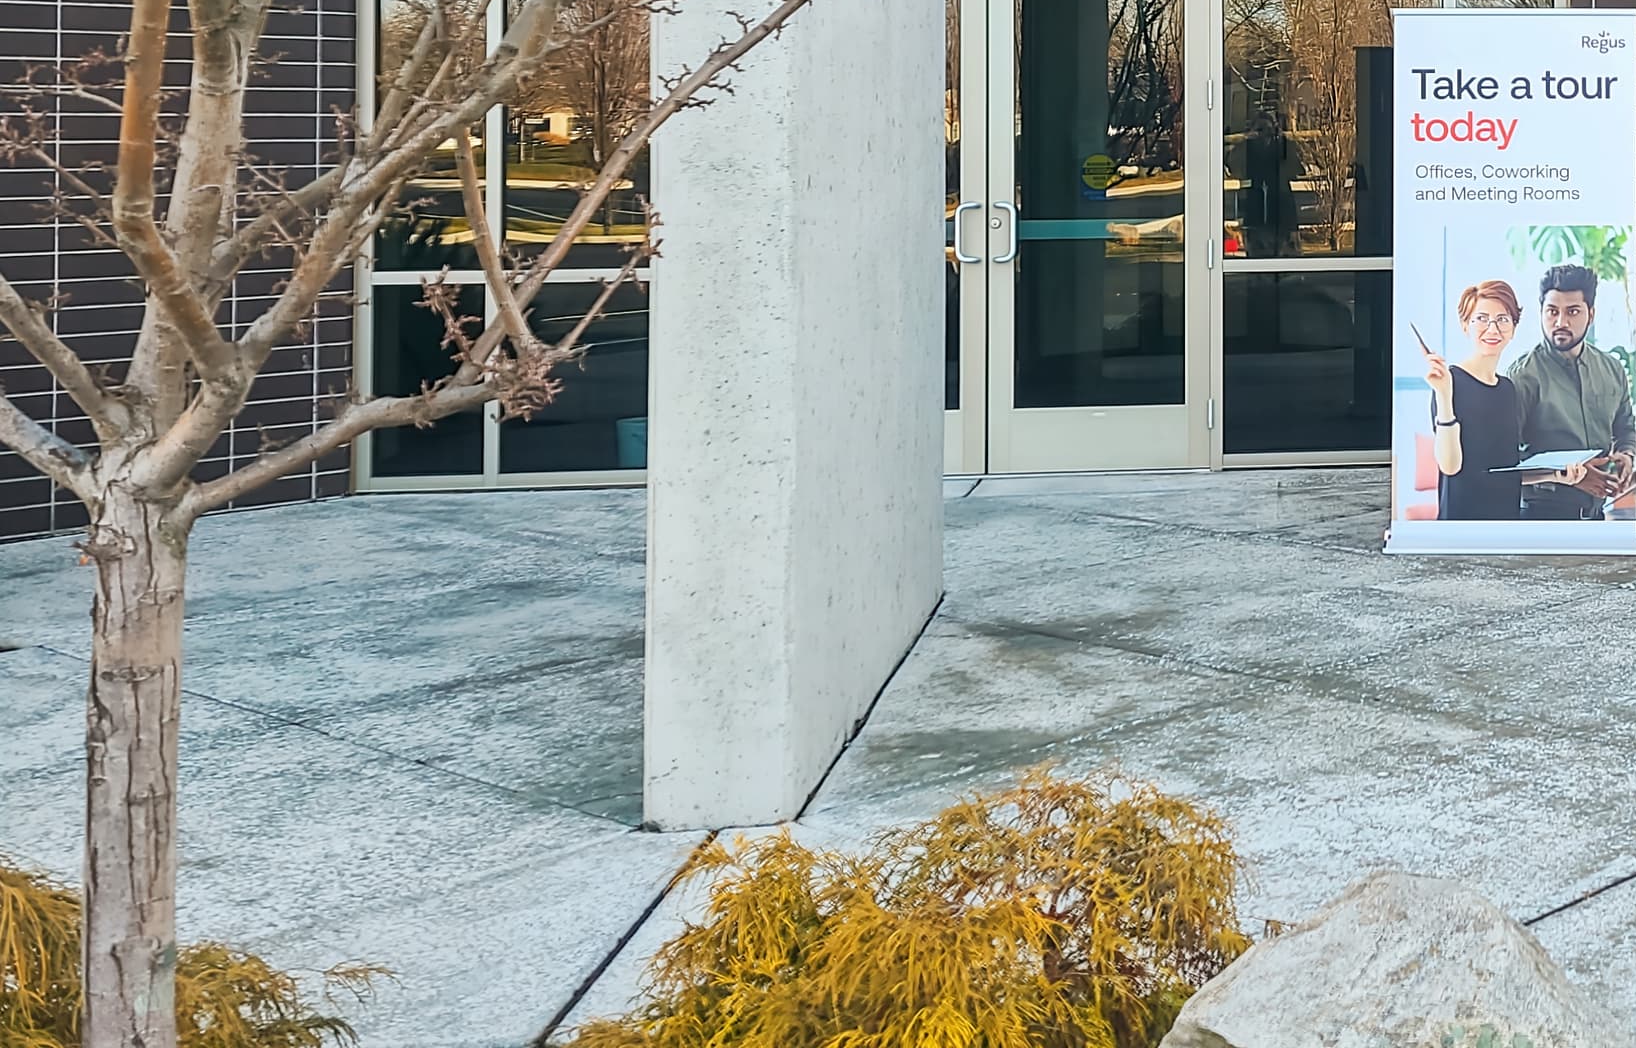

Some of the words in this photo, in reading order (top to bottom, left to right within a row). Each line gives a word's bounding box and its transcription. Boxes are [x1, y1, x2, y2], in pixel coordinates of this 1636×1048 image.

[1581, 34, 1626, 54] Regus
[1411, 68, 1499, 100] Take
[1510, 76, 1534, 100] a
[1541, 70, 1618, 100] tour
[1411, 111, 1518, 150] today
[1415, 164, 1477, 181] Offices,
[1482, 164, 1570, 181] Coworking
[1415, 186, 1446, 201] and
[1451, 186, 1518, 204] Meeting
[1523, 186, 1581, 201] Rooms
